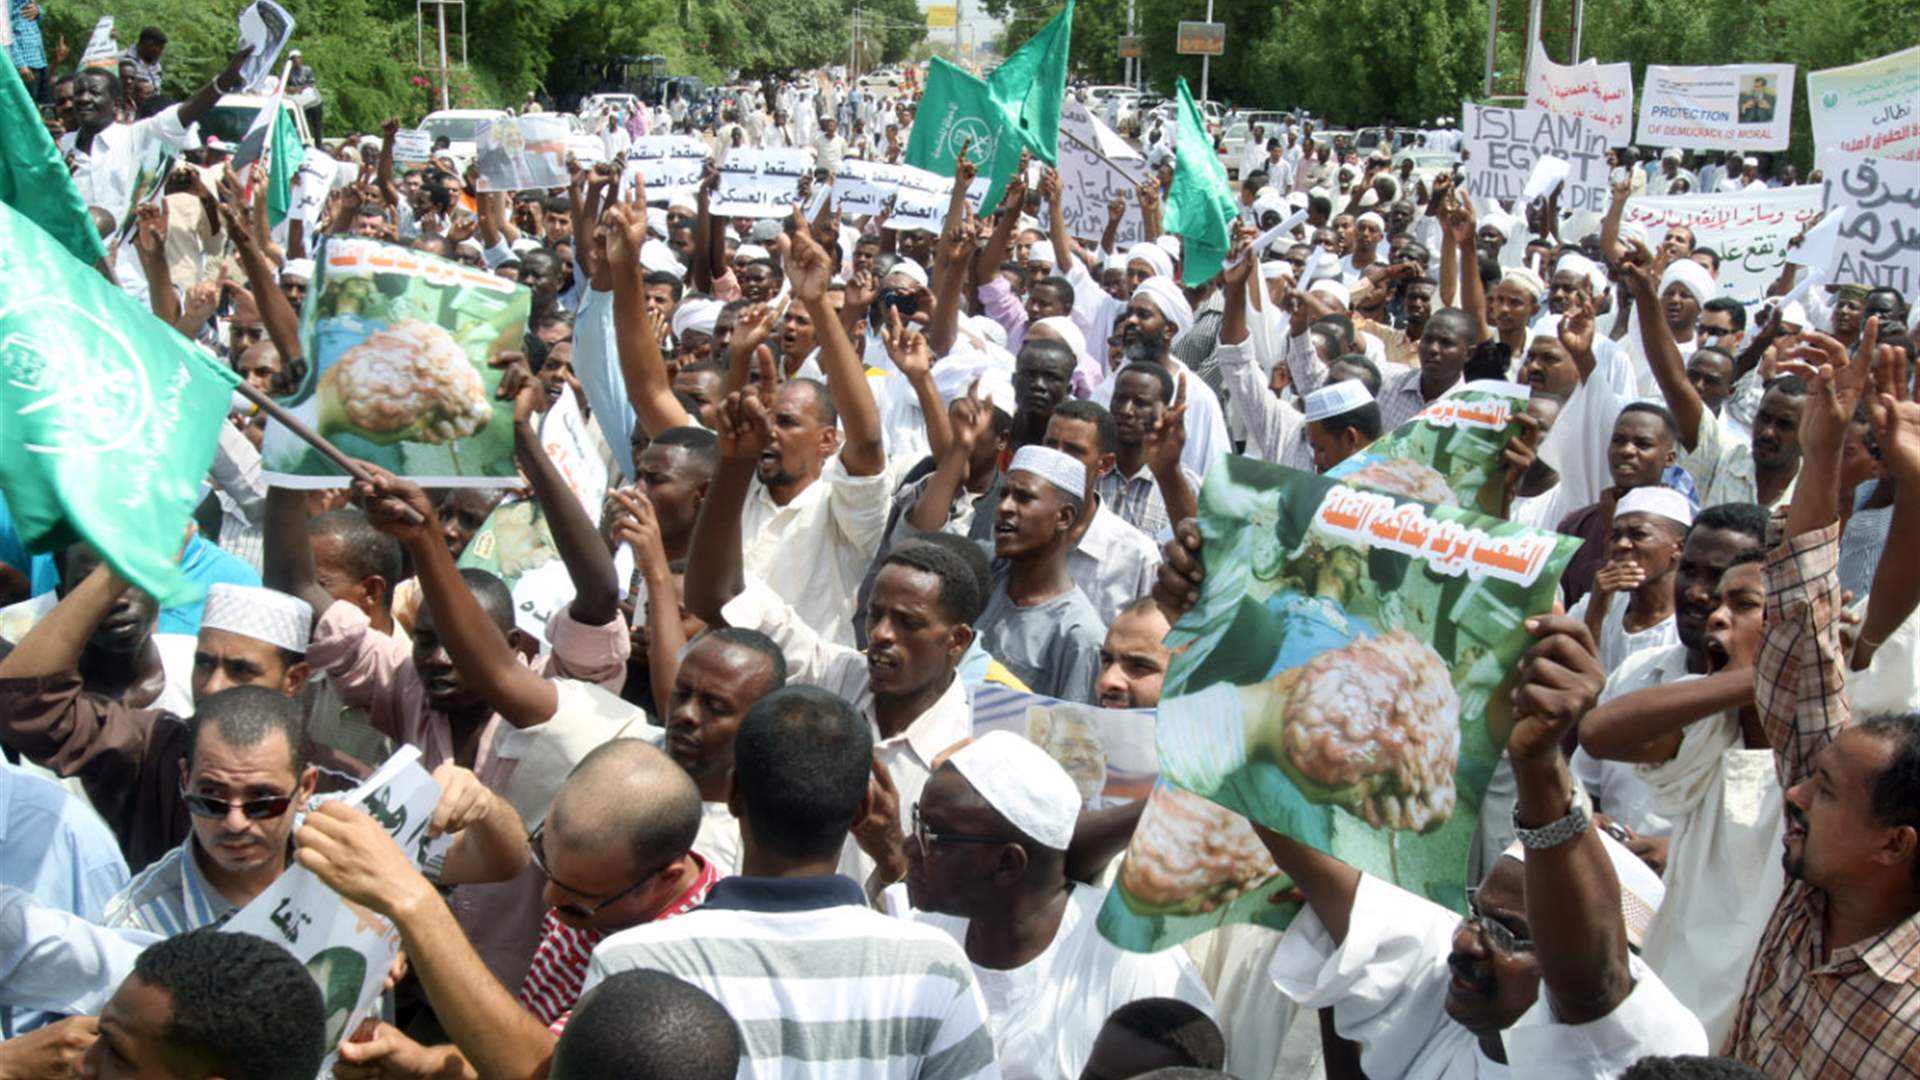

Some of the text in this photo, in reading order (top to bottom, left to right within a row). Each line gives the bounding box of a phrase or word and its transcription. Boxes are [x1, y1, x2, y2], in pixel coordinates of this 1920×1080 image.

[1651, 105, 1729, 122] PROTECTION
[1473, 106, 1582, 150] ISLAM
[1584, 128, 1608, 155] in
[1648, 124, 1773, 140] OF DEMOCRACY IS MORAL
[717, 187, 767, 205] العسكر
[1466, 169, 1518, 200] WILL
[1571, 184, 1607, 213] DIE
[1833, 250, 1909, 294] ANTI
[1456, 401, 1504, 427] الشعب
[1322, 491, 1546, 578] الشعب يريد محاكمة القتلة
